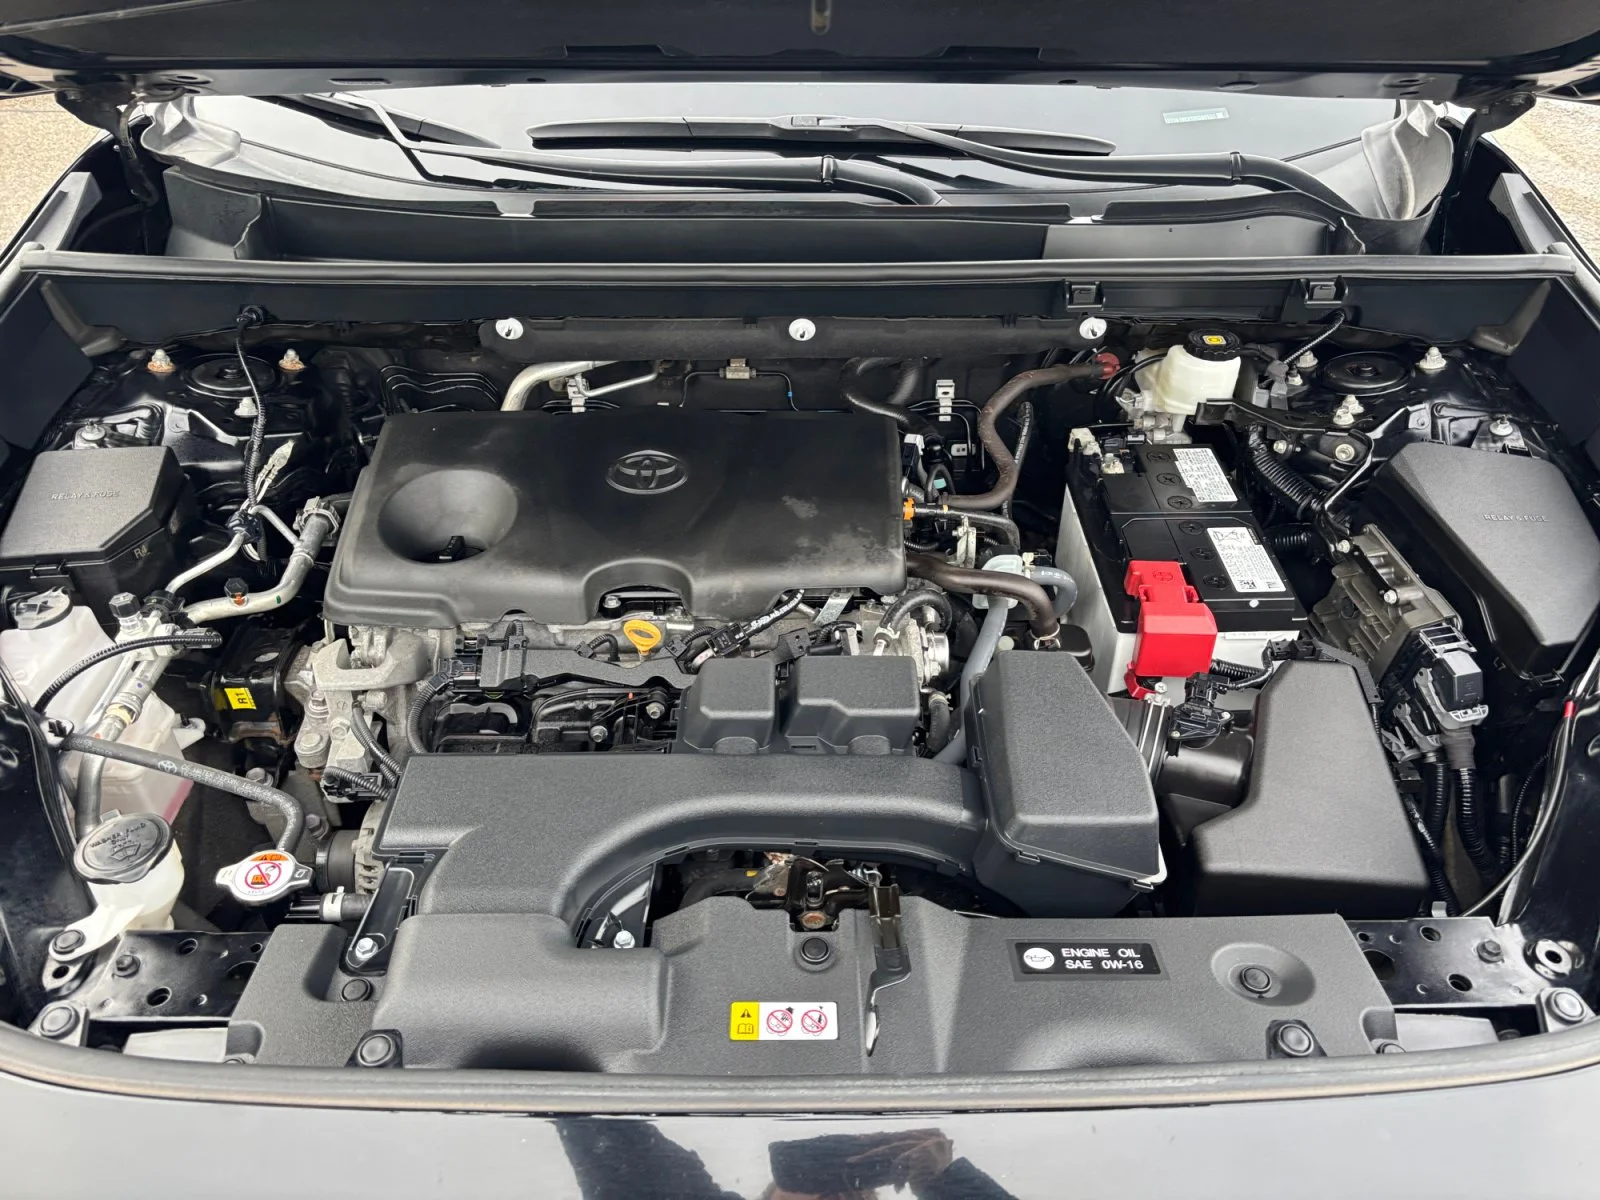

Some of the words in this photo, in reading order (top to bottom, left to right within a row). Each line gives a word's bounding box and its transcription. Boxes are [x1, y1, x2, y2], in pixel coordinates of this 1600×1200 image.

[51, 492, 83, 500] RELAY
[94, 490, 120, 498] FUSE
[1523, 514, 1549, 522] FUSE
[235, 692, 249, 704] R1
[1061, 948, 1110, 958] ENGINE
[1117, 948, 1141, 958] OIL
[1065, 960, 1093, 969] SAE
[1101, 960, 1144, 970] 0W-16
